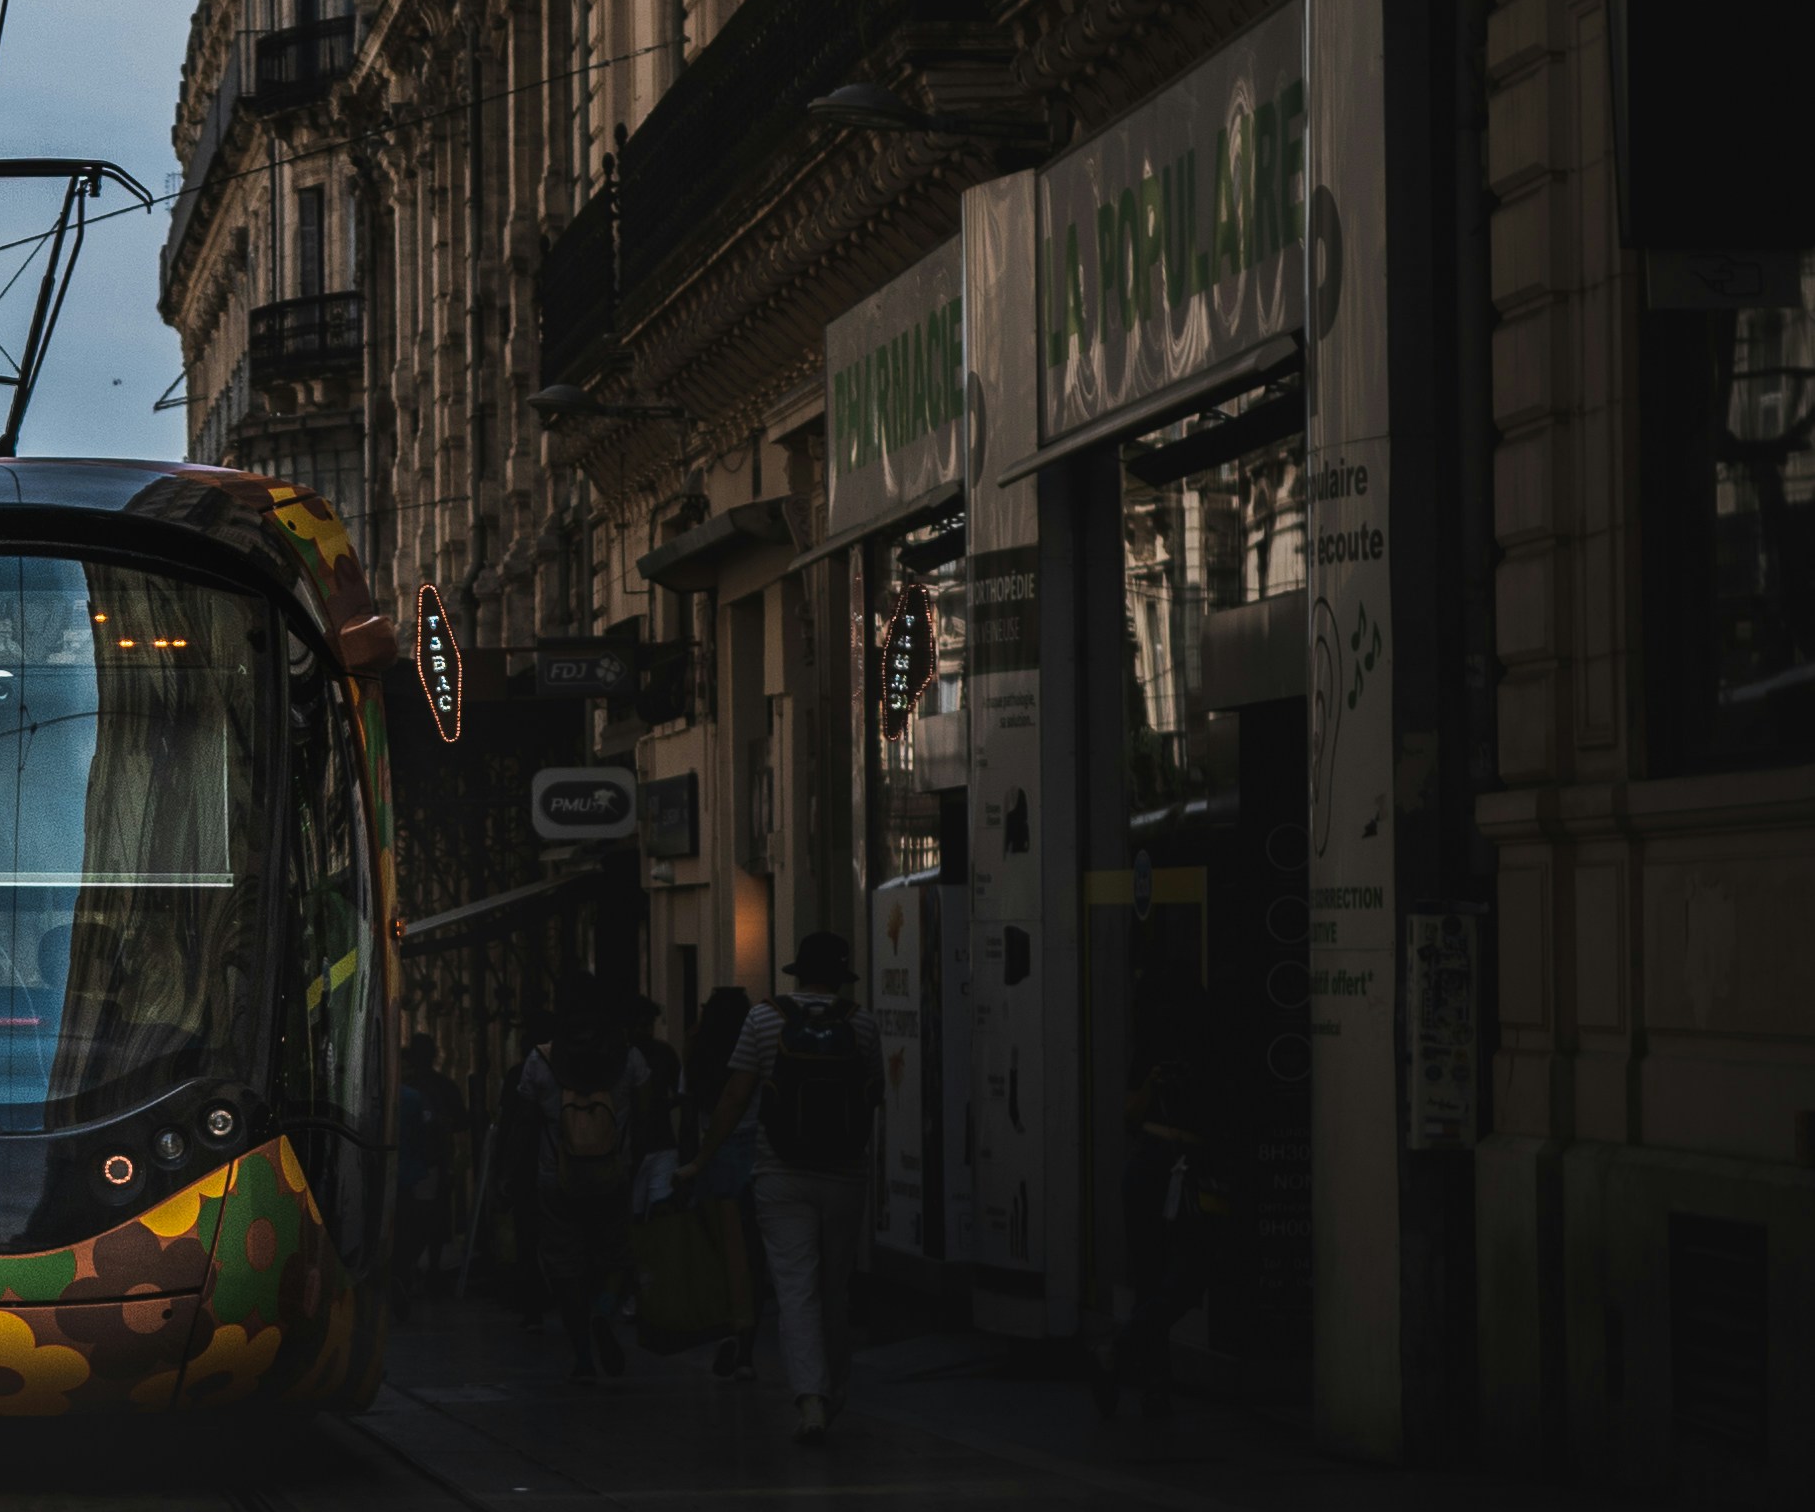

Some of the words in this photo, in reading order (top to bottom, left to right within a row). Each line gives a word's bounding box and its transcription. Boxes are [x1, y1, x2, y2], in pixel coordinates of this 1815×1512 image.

[1045, 223, 1085, 368] LA
[1097, 78, 1304, 345] POPULAIRE
[834, 296, 964, 480] PHARMACIE
[1317, 524, 1384, 566] écoute
[427, 615, 453, 712] TABAC
[550, 662, 587, 679] FDJ
[550, 797, 592, 813] PMU
